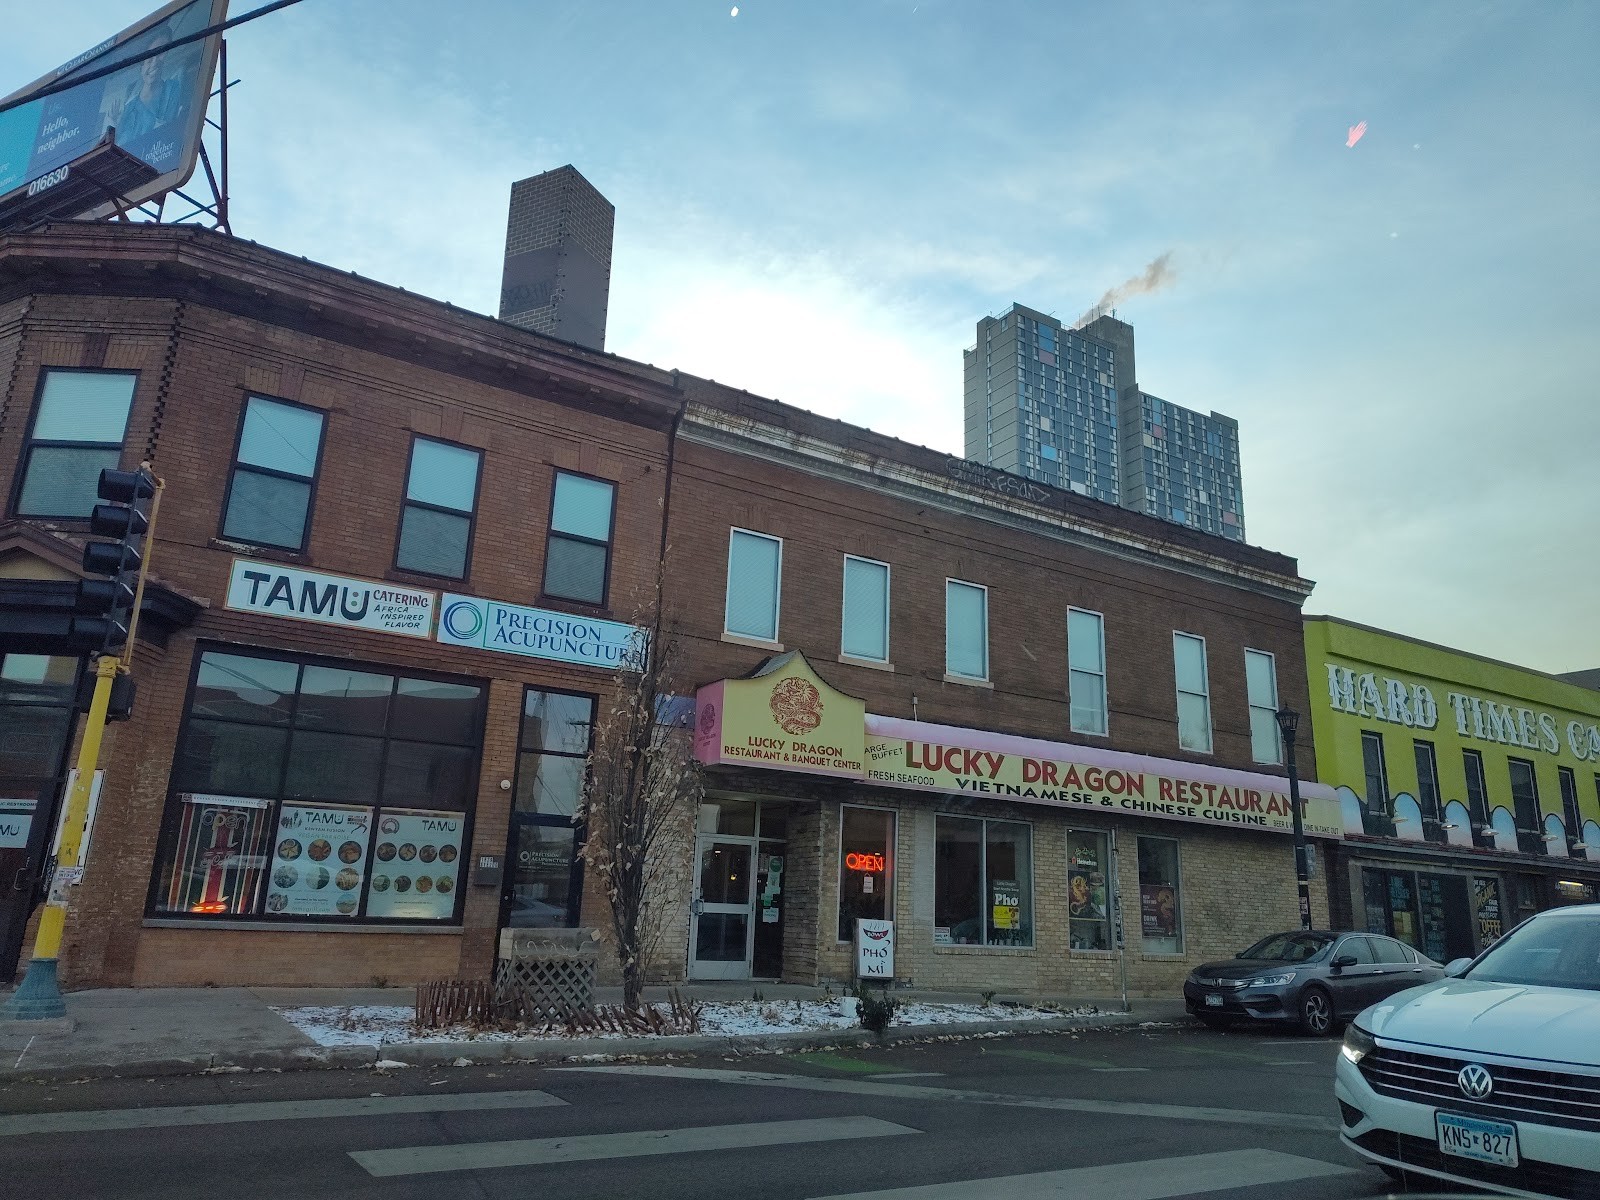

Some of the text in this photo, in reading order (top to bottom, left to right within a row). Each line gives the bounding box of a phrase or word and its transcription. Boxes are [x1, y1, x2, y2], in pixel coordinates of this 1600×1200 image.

[41, 116, 69, 137] Hello,
[37, 127, 80, 154] neighbor.
[28, 165, 69, 196] 016630
[243, 570, 370, 621] TAMU
[373, 589, 429, 608] CATERING
[374, 604, 409, 613] AFRICA
[380, 613, 424, 621] INSPIRED
[384, 621, 420, 629] FLAVOR
[495, 608, 602, 642] PRECISION
[1324, 662, 1438, 730] HARD
[1447, 691, 1560, 755] TIMES
[748, 736, 843, 757] LUCKY DRAGON
[863, 743, 887, 755] ARGE
[871, 747, 904, 761] BUFFET
[724, 745, 861, 771] RESTAURANT & BANQUET CENTER
[868, 770, 935, 786] FRESH SEAFOOD
[906, 741, 1309, 819] LUCKY DRAGON RESTAURANT
[955, 778, 1268, 826] VIETNAMESE & CHINESE CUISINE
[202, 812, 248, 831] open
[305, 811, 344, 825] TAMU
[422, 820, 457, 832] TAMU
[846, 852, 885, 872] OPEN
[1442, 1125, 1511, 1157] KNS 827
